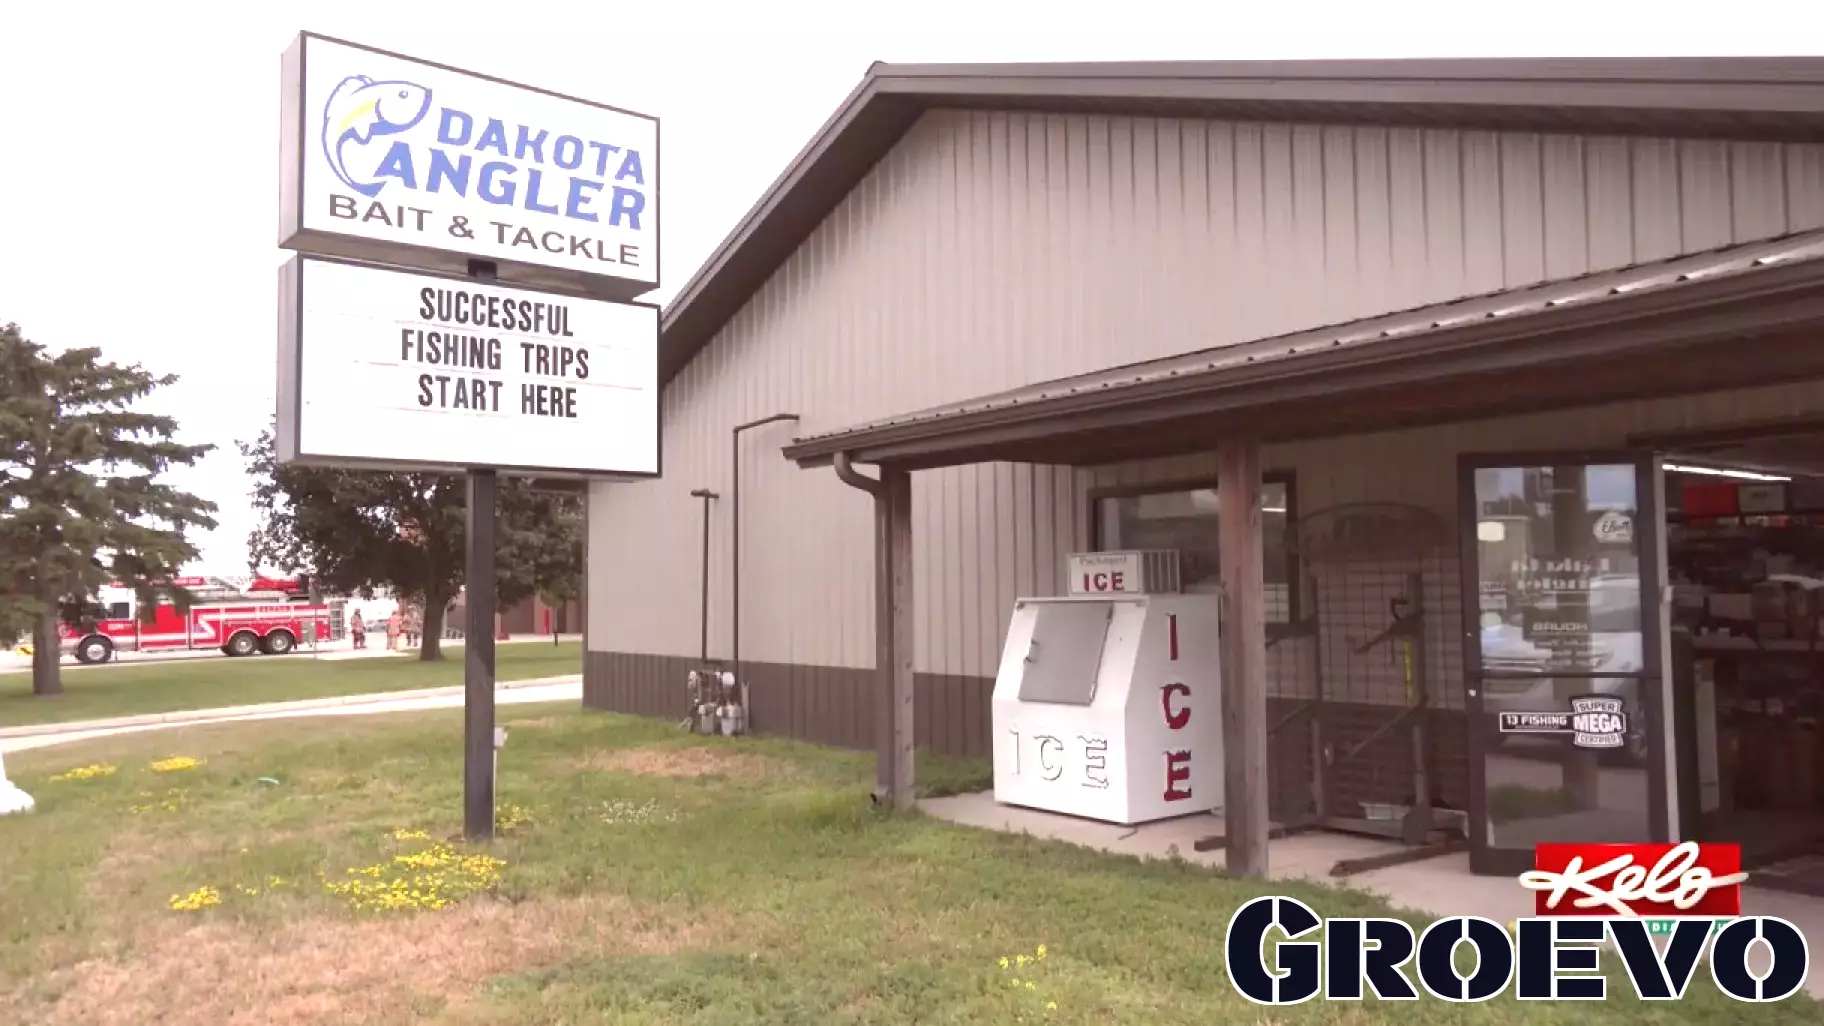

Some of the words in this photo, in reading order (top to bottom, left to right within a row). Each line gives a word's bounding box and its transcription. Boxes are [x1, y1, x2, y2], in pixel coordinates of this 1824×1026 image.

[436, 106, 645, 185] DAKOTA
[373, 140, 646, 230] ANGLER
[329, 194, 432, 231] BAIT
[448, 216, 474, 239] &
[489, 221, 640, 267] TACKLE
[420, 287, 574, 337] SUCCESSFUL
[401, 329, 501, 370] FISHING
[520, 342, 589, 379] TRIPS
[418, 374, 503, 412] START
[521, 384, 577, 418] HERE
[1083, 572, 1125, 592] ICE
[1161, 613, 1193, 802] ICE
[1506, 715, 1519, 726] 13
[1521, 715, 1567, 726] FISHING
[1573, 713, 1622, 733] MEGA
[1579, 702, 1615, 711] SUPER
[1009, 727, 1109, 790] ICE
